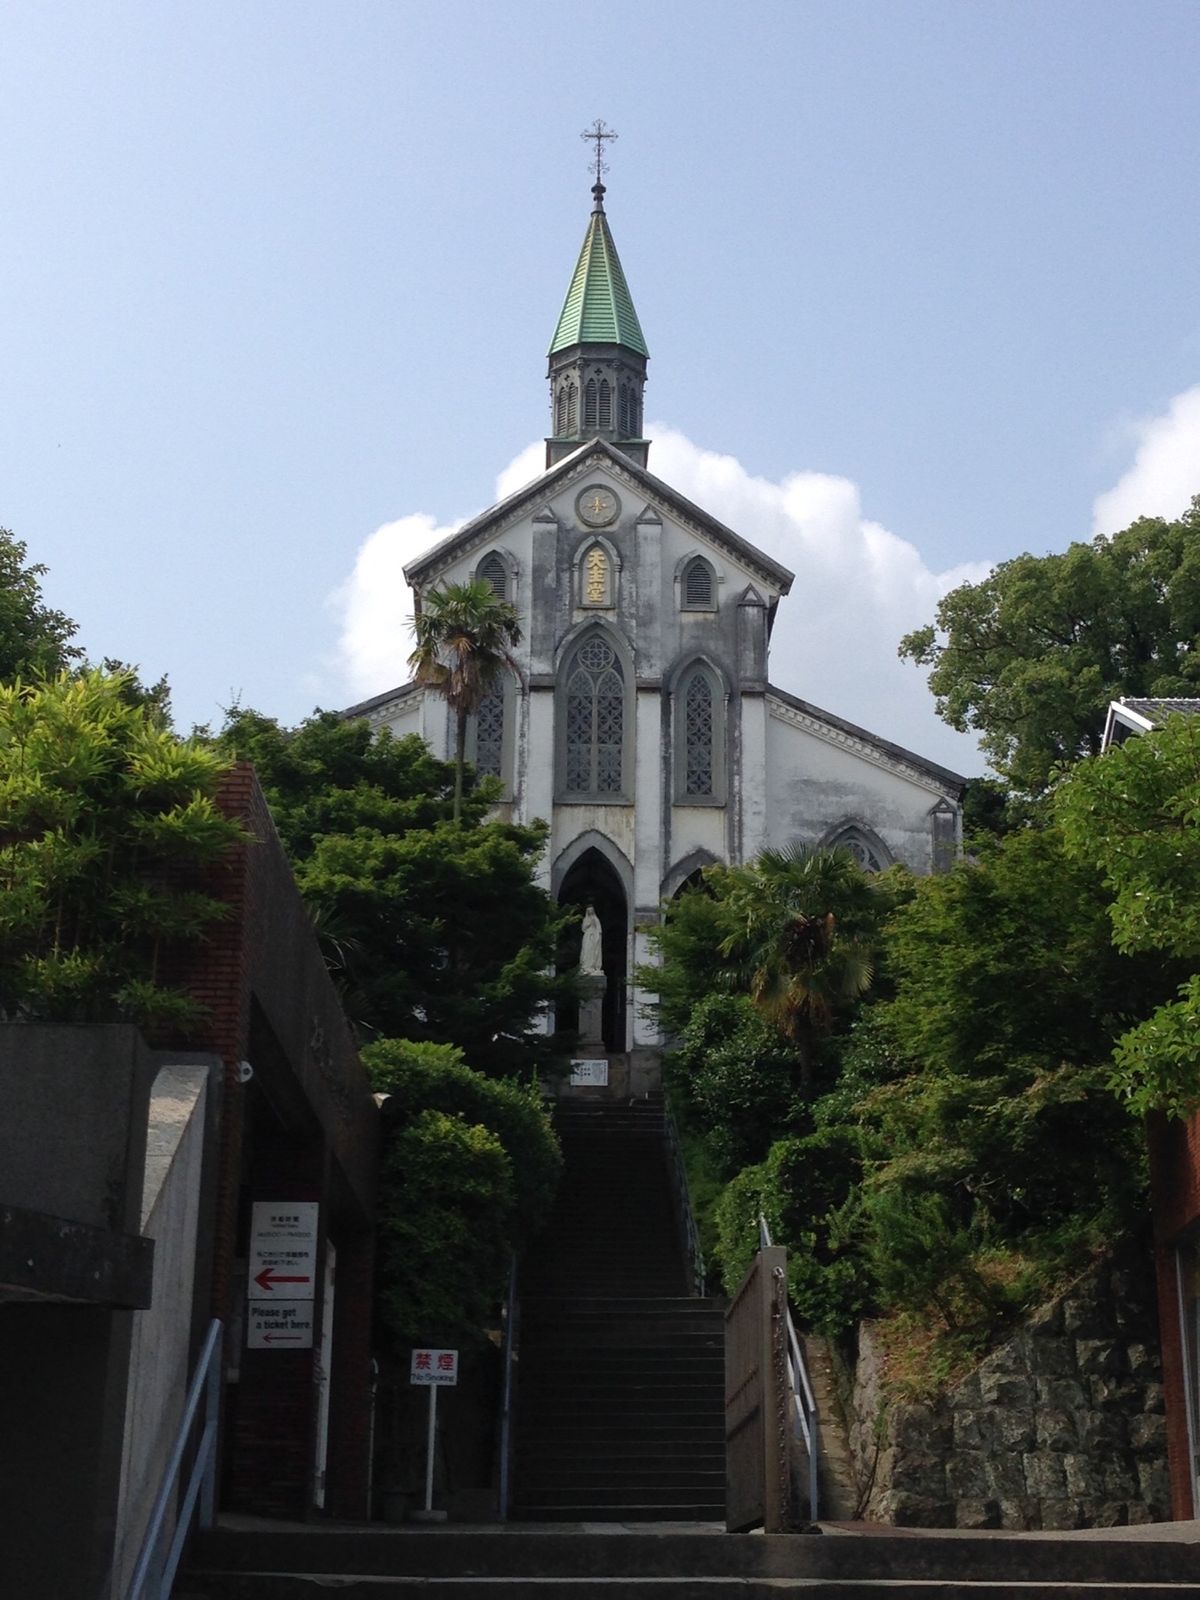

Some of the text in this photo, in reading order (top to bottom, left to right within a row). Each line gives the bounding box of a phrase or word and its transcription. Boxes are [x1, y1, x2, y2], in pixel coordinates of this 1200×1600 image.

[586, 551, 608, 603] 天主堂
[251, 1307, 297, 1319] Please get
[264, 1320, 289, 1330] ticket
[415, 1353, 454, 1370] 禁煙
[411, 1373, 455, 1382] No Smoking
